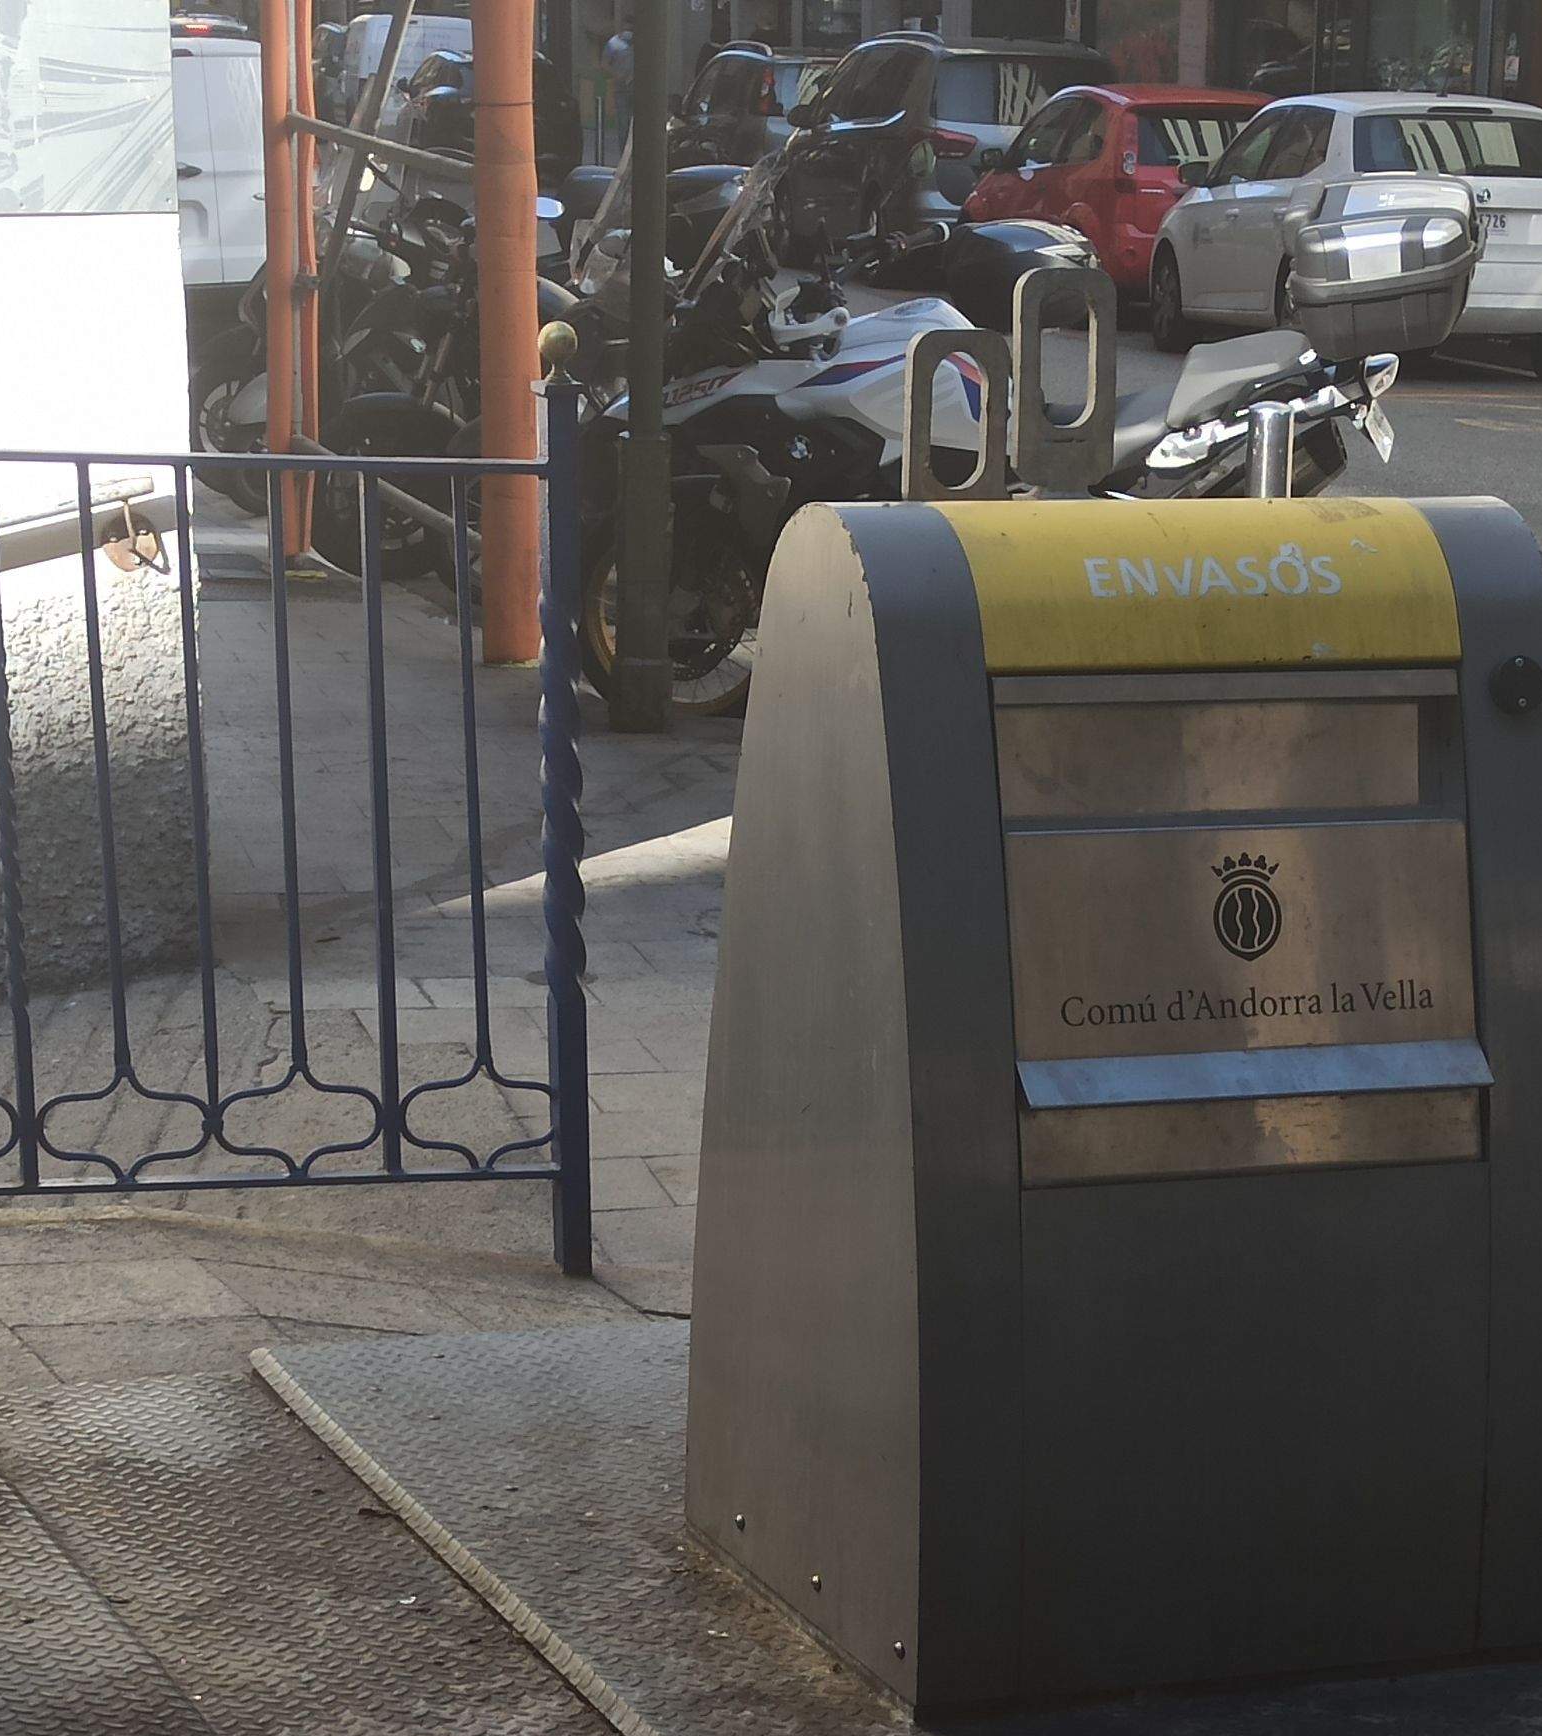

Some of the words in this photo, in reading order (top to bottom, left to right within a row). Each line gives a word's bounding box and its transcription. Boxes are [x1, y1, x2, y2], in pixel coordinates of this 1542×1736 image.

[1060, 994, 1158, 1028] Comú
[1330, 982, 1357, 1014] la
[1359, 978, 1435, 1011] Vella
